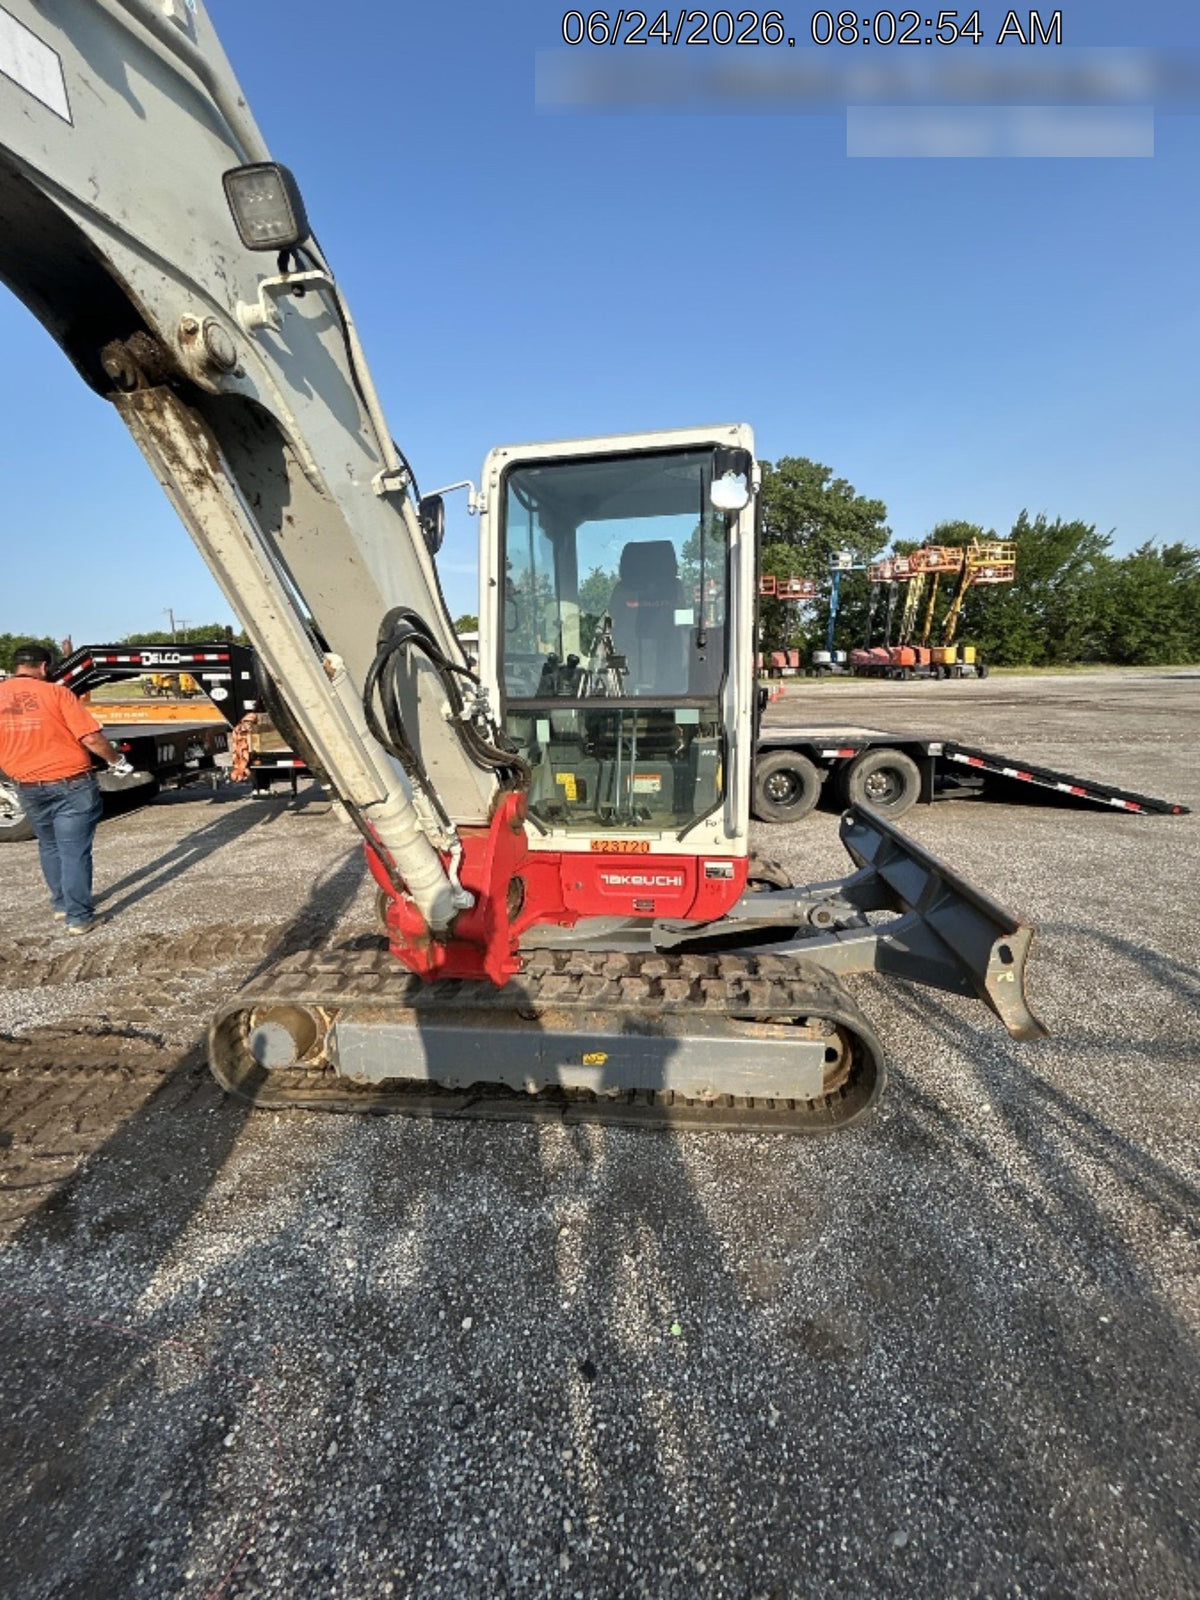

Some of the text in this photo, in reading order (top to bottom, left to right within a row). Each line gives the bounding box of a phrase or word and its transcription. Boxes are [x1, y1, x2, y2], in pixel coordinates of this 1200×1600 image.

[141, 651, 181, 665] DELCO
[591, 840, 650, 853] 423720
[600, 874, 682, 887] TAKEUCHI
